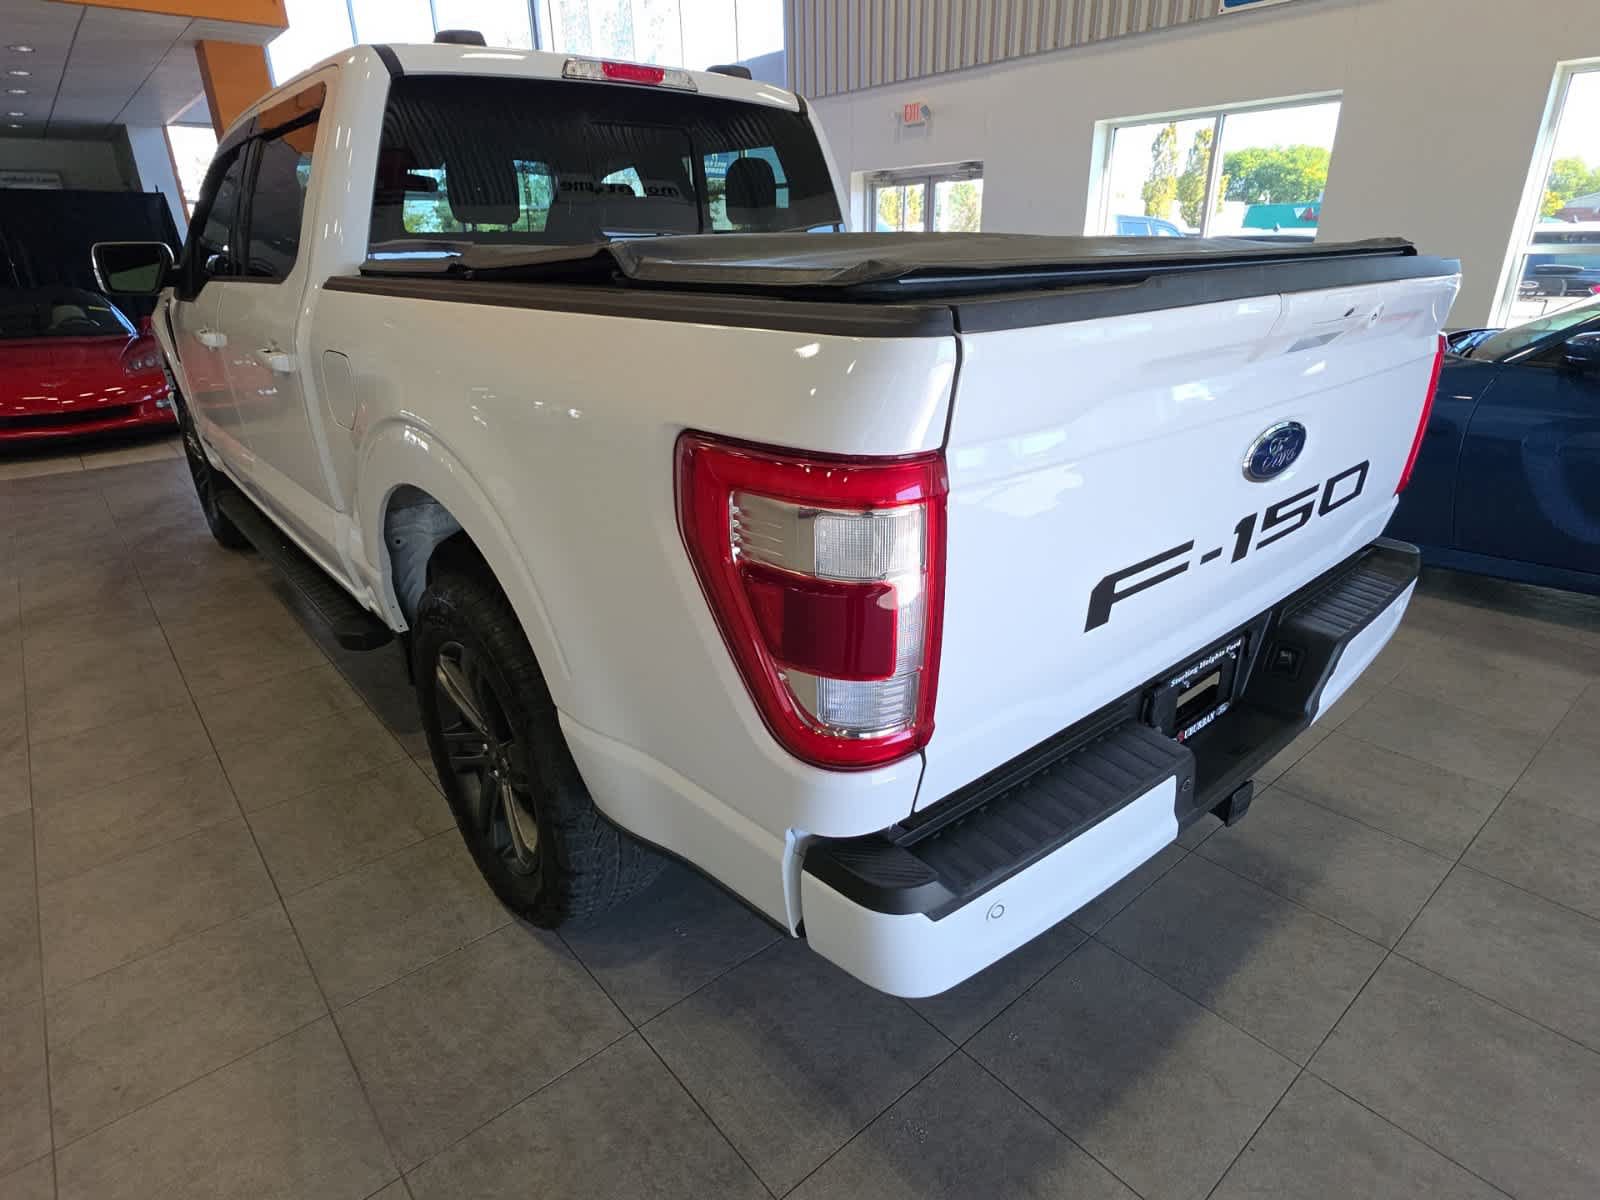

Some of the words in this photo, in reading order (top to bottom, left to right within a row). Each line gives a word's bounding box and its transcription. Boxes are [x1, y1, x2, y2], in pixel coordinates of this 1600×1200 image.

[904, 103, 920, 122] EXIT
[1084, 459, 1370, 633] F-150
[1226, 639, 1241, 654] Ford
